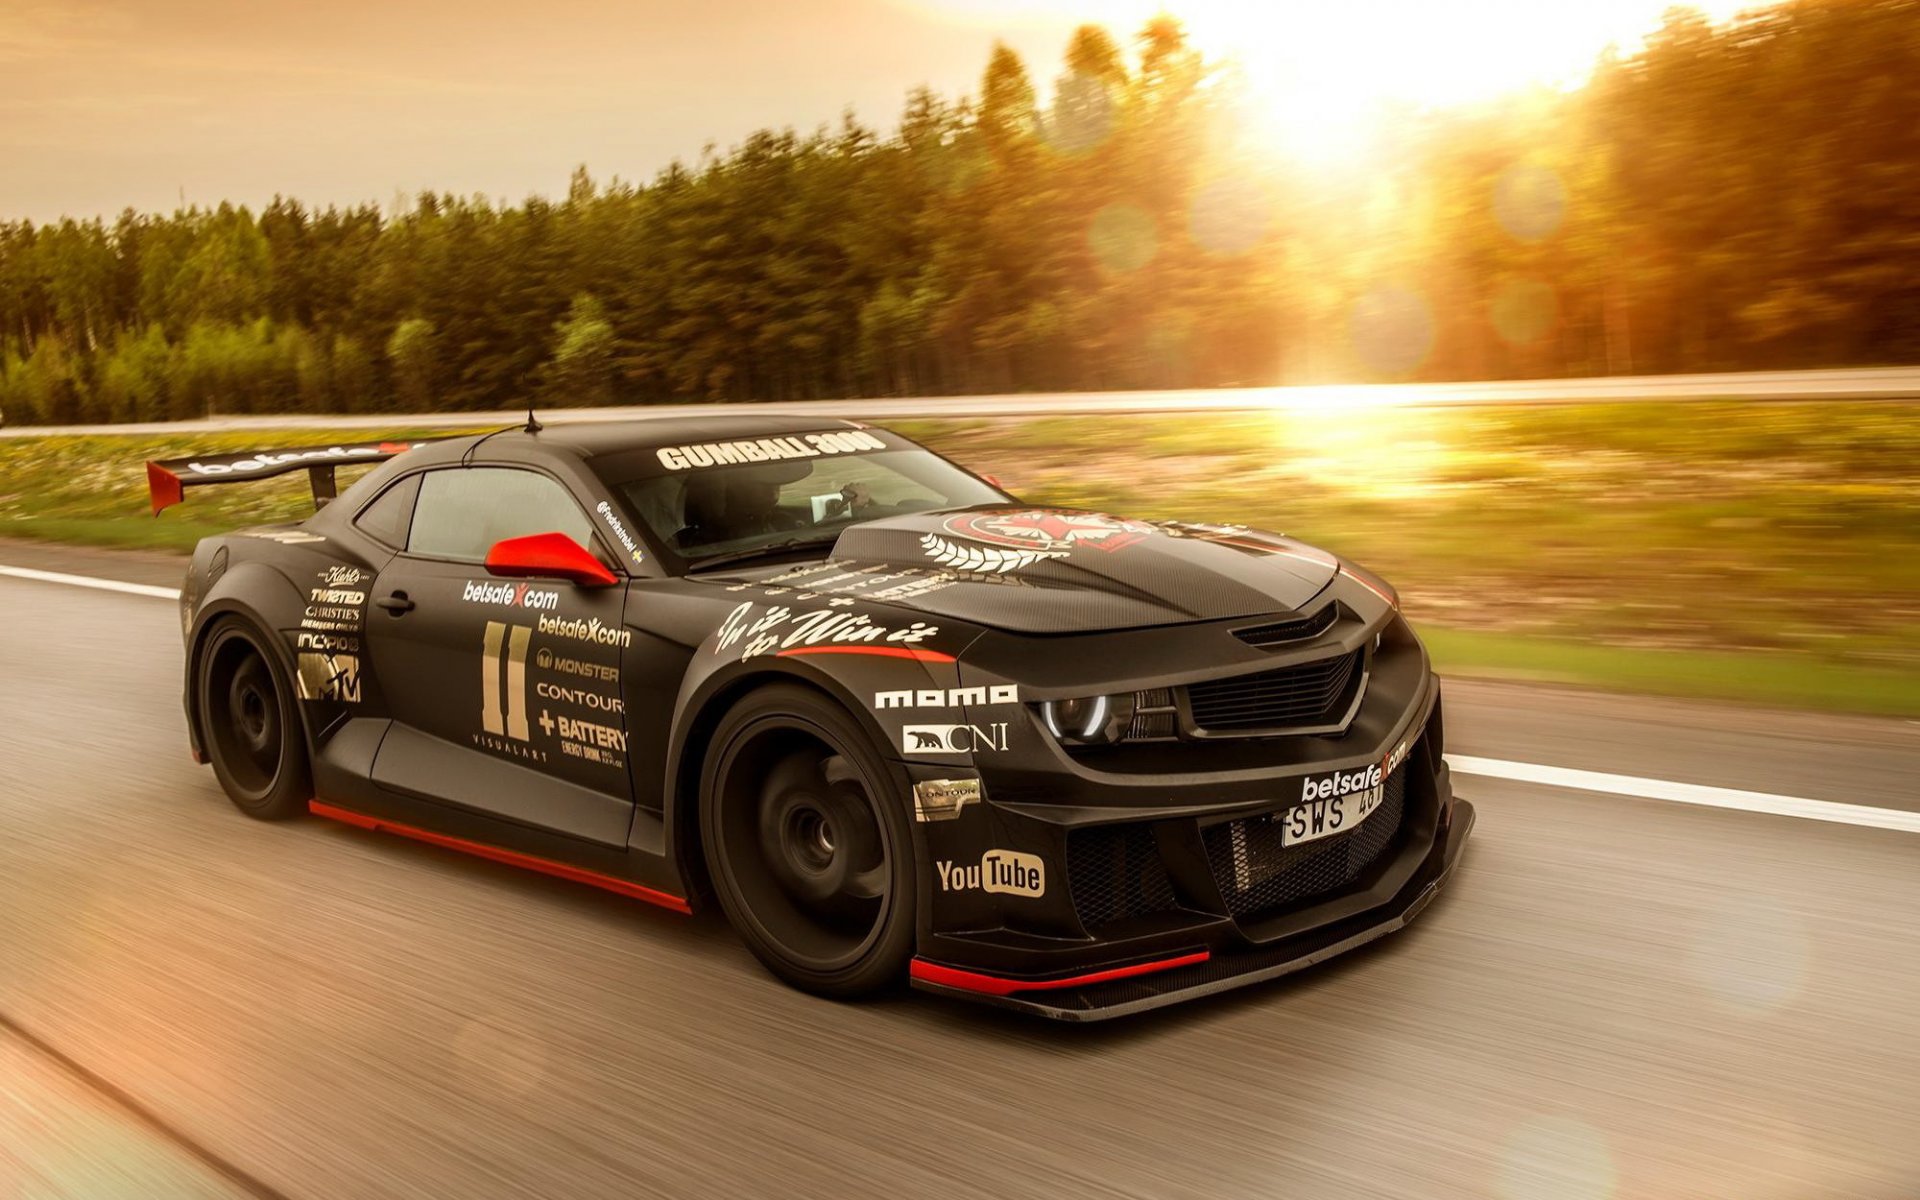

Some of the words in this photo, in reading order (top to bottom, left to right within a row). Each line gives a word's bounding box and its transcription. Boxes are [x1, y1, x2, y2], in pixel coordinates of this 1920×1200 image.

[656, 436, 821, 470] GUMBALL
[311, 588, 365, 605] TWISTED
[305, 606, 359, 620] CHRISTIE'S
[747, 606, 791, 637] it
[886, 622, 939, 642] it
[297, 652, 361, 702] MTV
[554, 657, 620, 682] MONSTER
[536, 682, 626, 715] CONTOUR
[558, 715, 629, 752] BATTERY
[946, 723, 1009, 753] CNI
[1291, 798, 1343, 838] SWS
[936, 856, 1040, 891] YouTube
